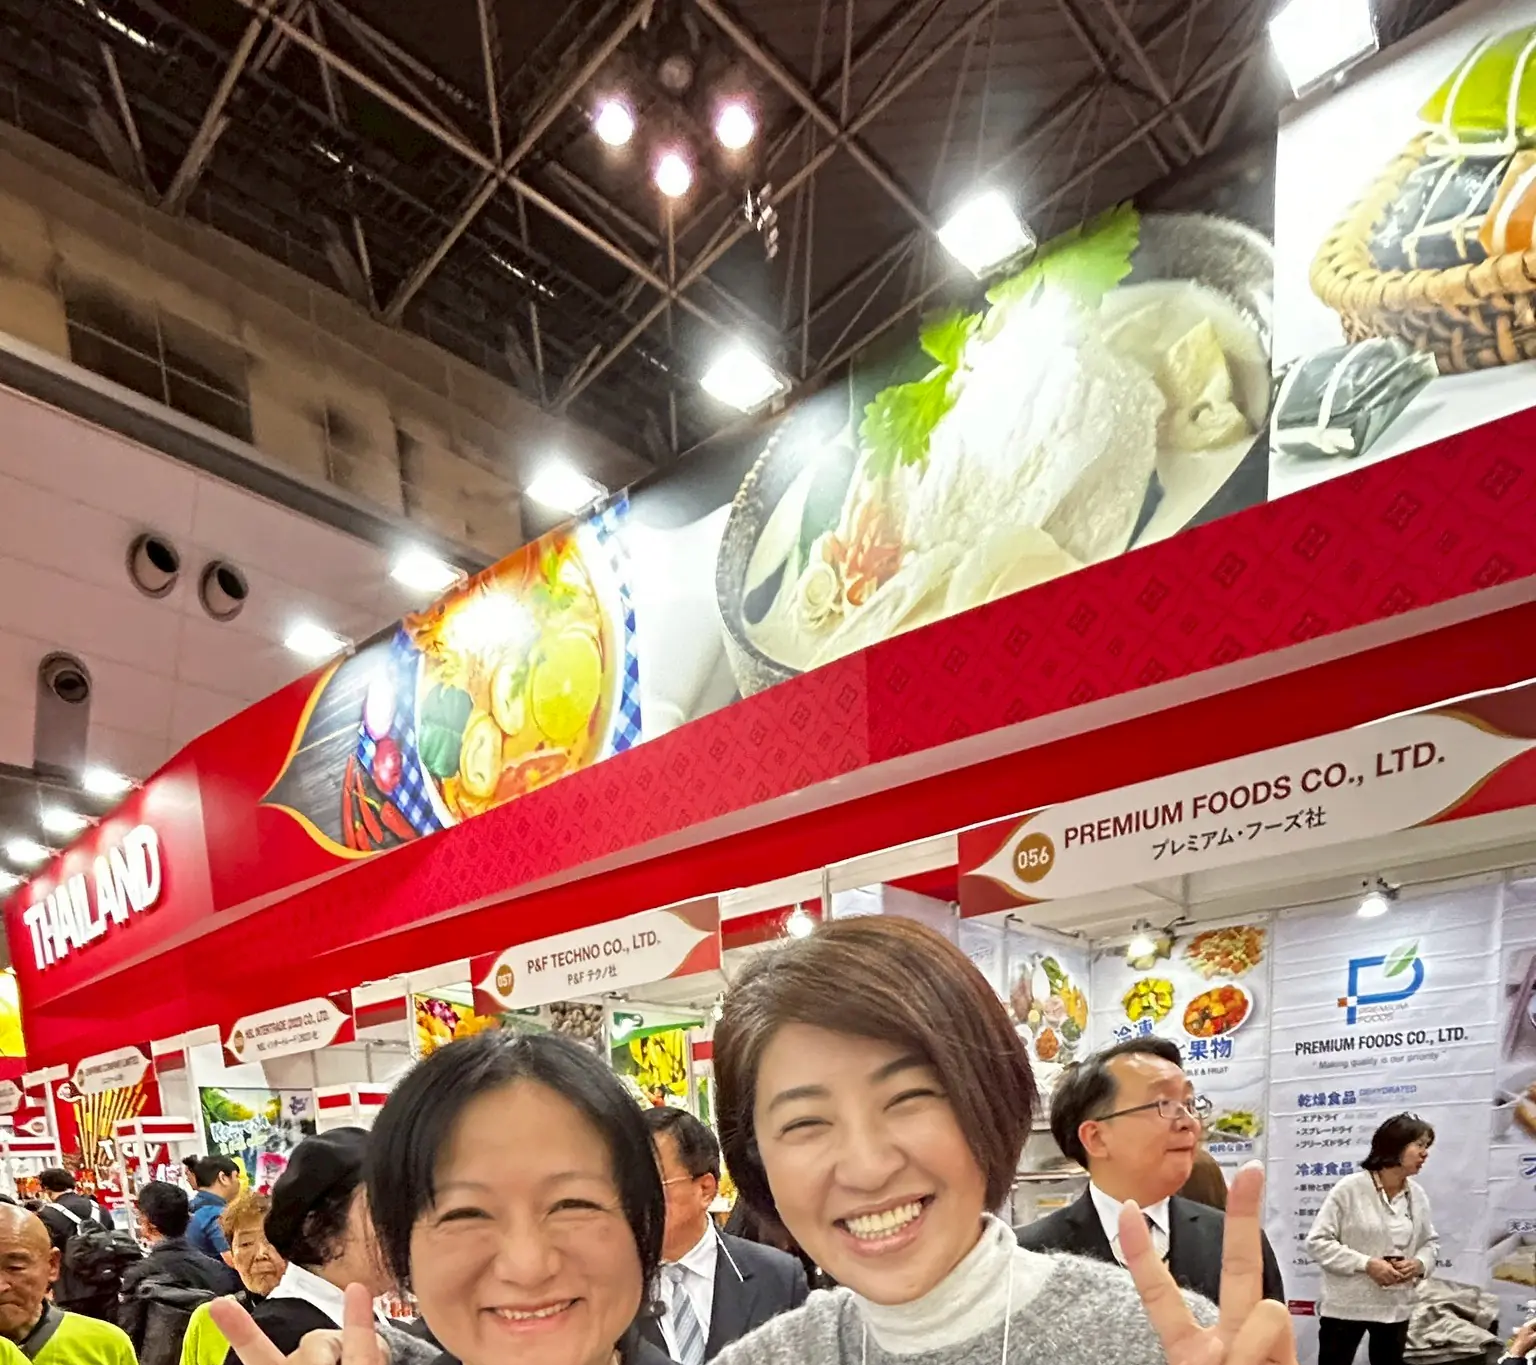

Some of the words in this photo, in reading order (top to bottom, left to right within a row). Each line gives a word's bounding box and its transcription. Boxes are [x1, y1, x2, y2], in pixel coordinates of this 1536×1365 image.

[1064, 801, 1184, 849] PREMIUM
[1192, 775, 1292, 820] FOODS
[1299, 766, 1365, 794] CO.,
[1375, 741, 1447, 778] LTD.
[1151, 805, 1328, 861] プレミアム・フーズ社
[1017, 846, 1051, 870] 056
[23, 825, 162, 971] THAILAND
[527, 956, 549, 975] P&F
[551, 943, 601, 969] TECHNO
[632, 930, 662, 951] LTD.
[567, 969, 586, 986] P&F
[1182, 1037, 1233, 1060] 果物
[1295, 1037, 1355, 1056] PREMIUM
[1358, 1032, 1403, 1050] FOODS
[1406, 1030, 1434, 1046] CO.,
[1438, 1026, 1469, 1043] LTD.
[1297, 1090, 1357, 1108] 乾燥食品
[1296, 1161, 1354, 1177] 冷凍食品
